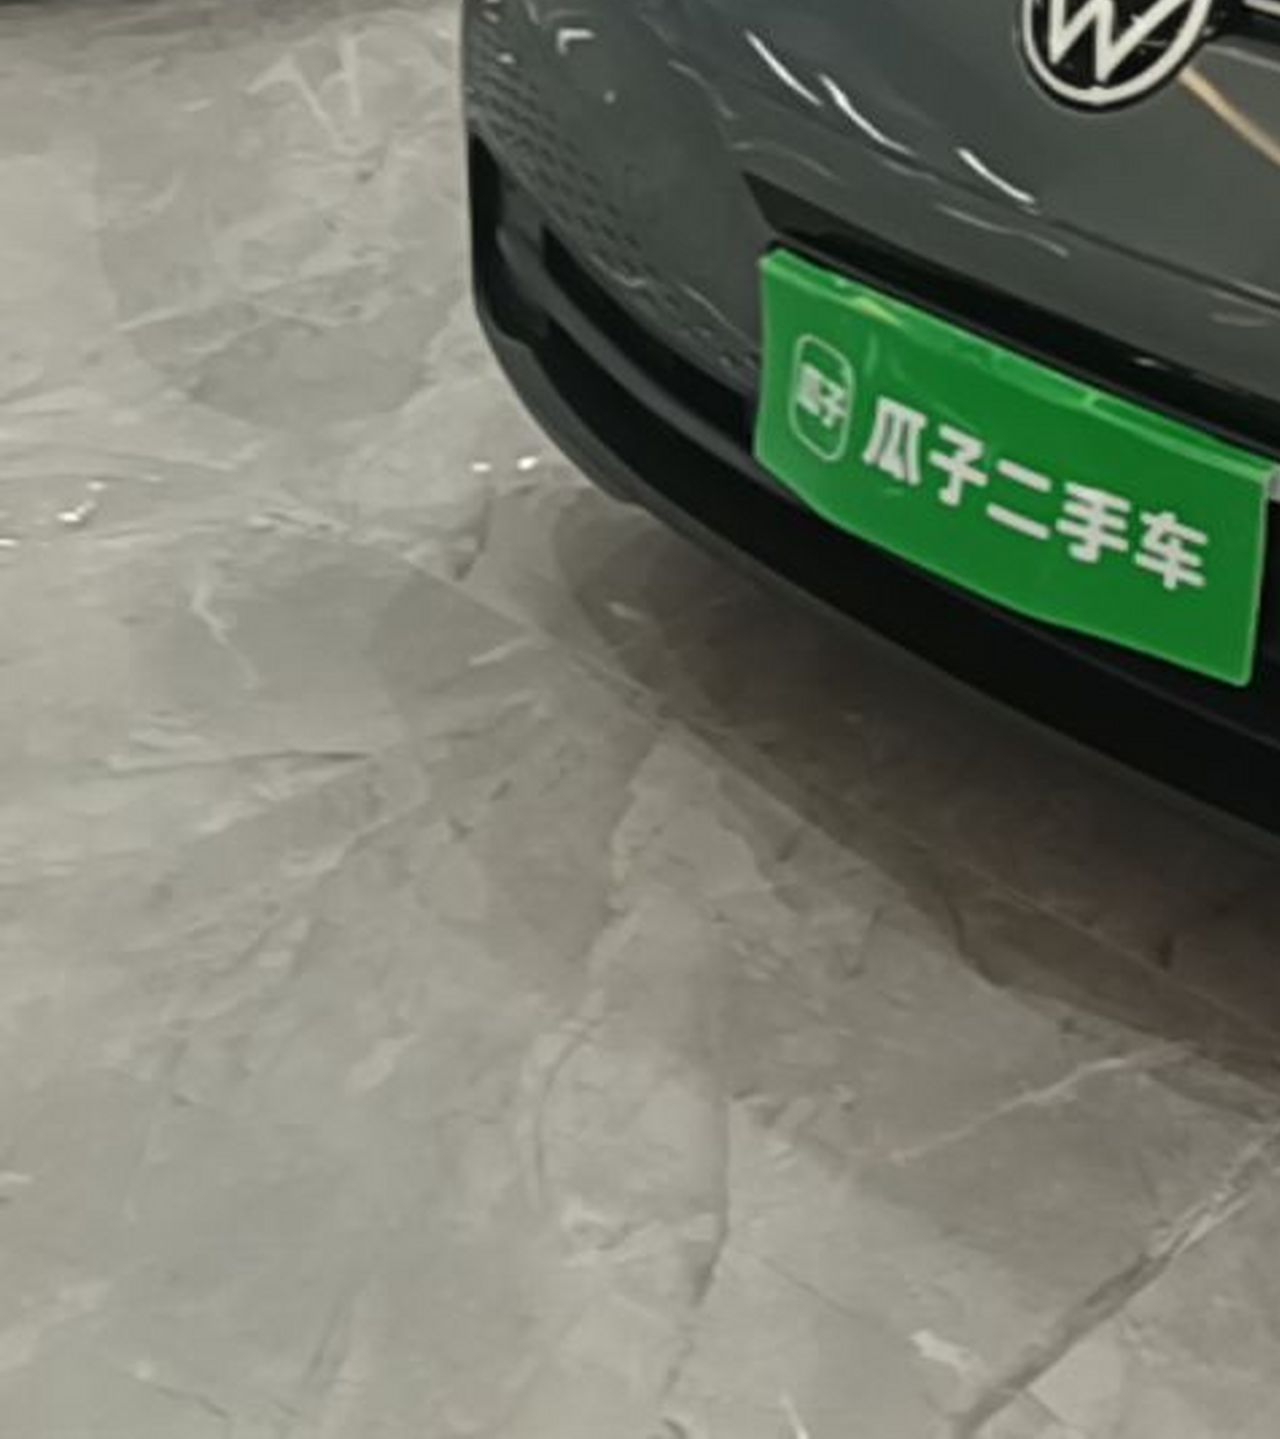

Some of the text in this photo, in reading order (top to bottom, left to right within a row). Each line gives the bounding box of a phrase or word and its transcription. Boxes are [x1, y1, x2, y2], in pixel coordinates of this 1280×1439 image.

[863, 395, 1208, 590] 瓜子二手车
